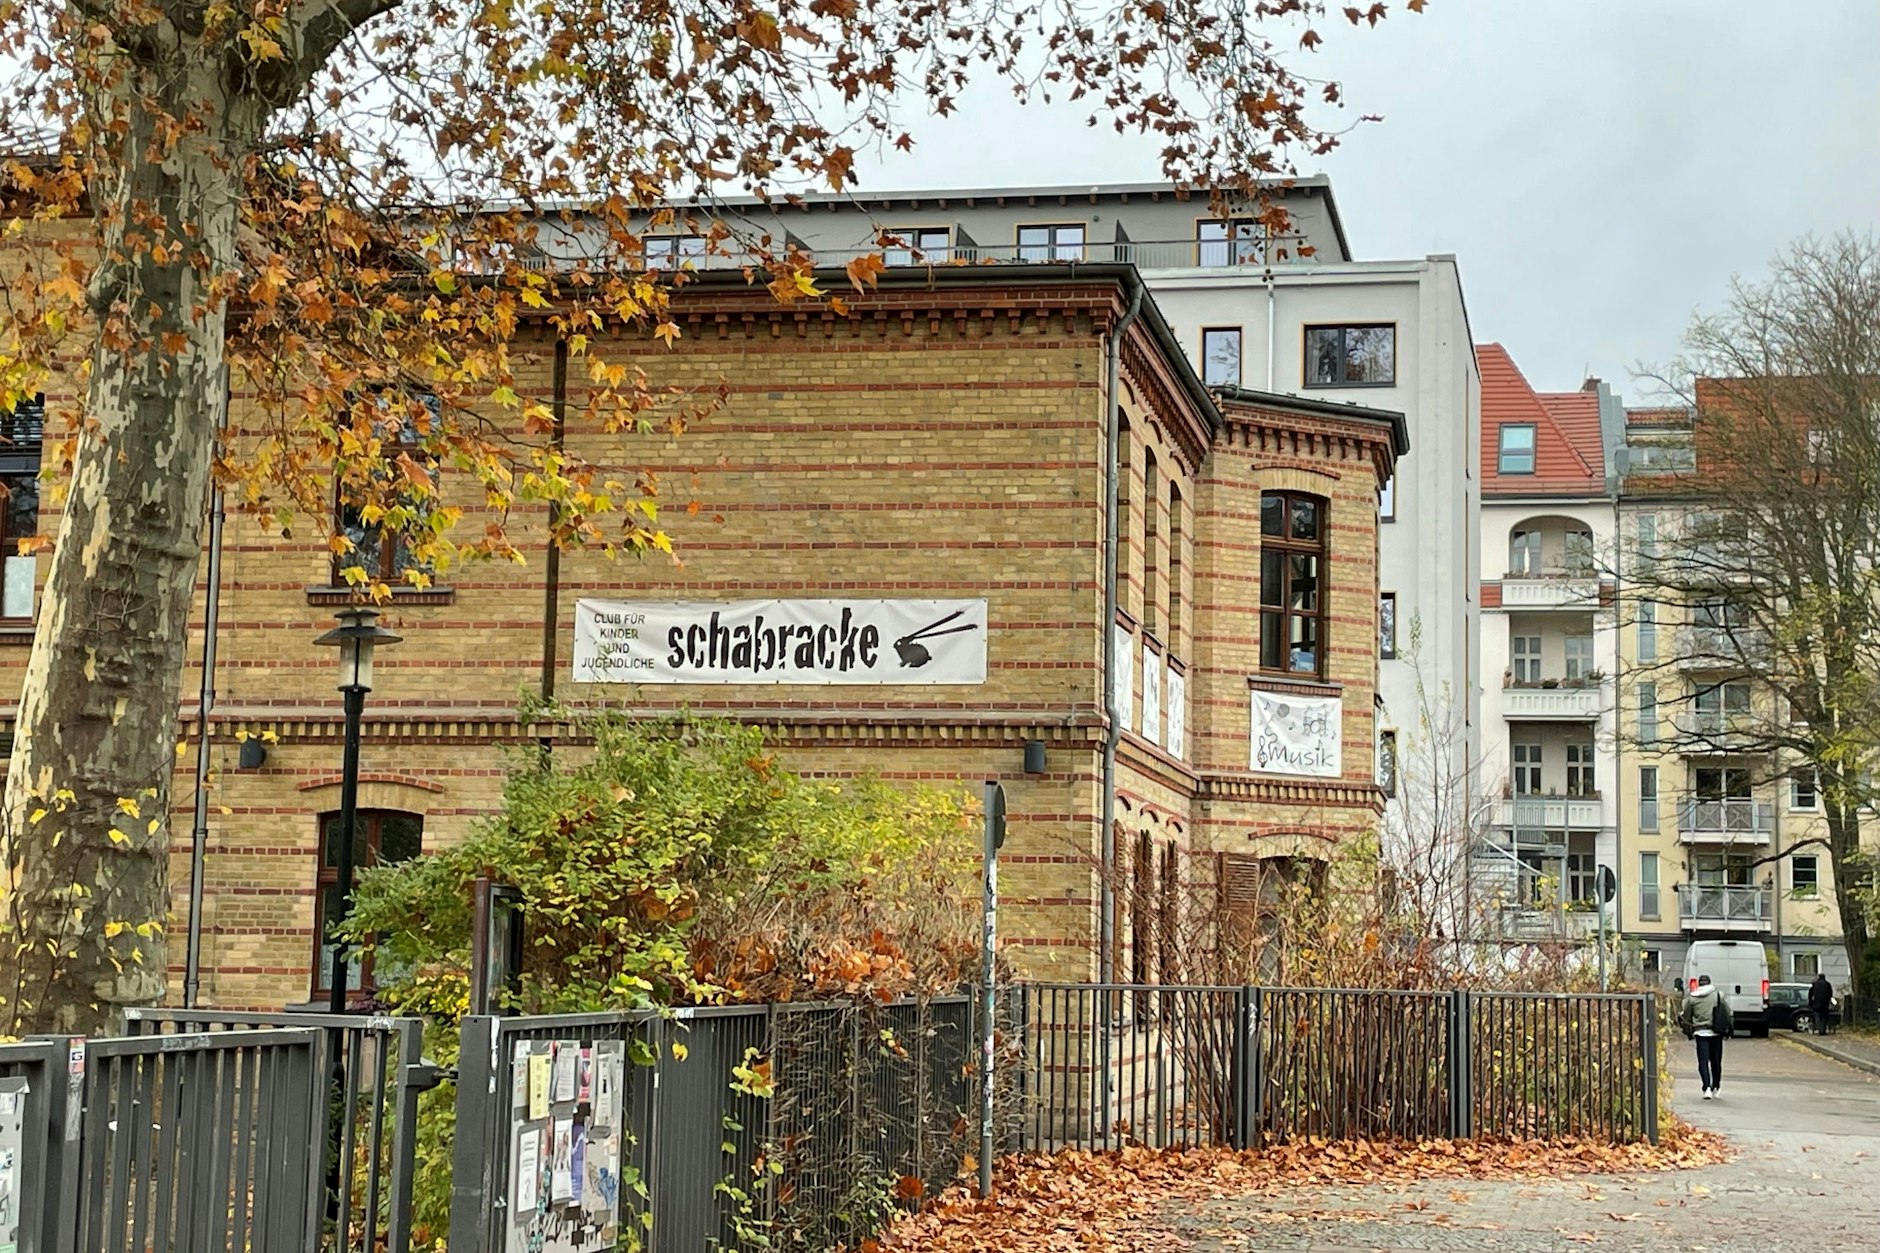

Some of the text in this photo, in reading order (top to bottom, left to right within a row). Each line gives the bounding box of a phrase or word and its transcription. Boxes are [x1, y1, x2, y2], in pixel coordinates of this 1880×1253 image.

[594, 613, 646, 624] CLUB FÜR
[600, 628, 639, 639] KINDER
[667, 607, 879, 673] schabracke
[604, 643, 630, 654] UND
[581, 657, 655, 669] JUGENDLICHE
[1268, 742, 1334, 767] Musik
